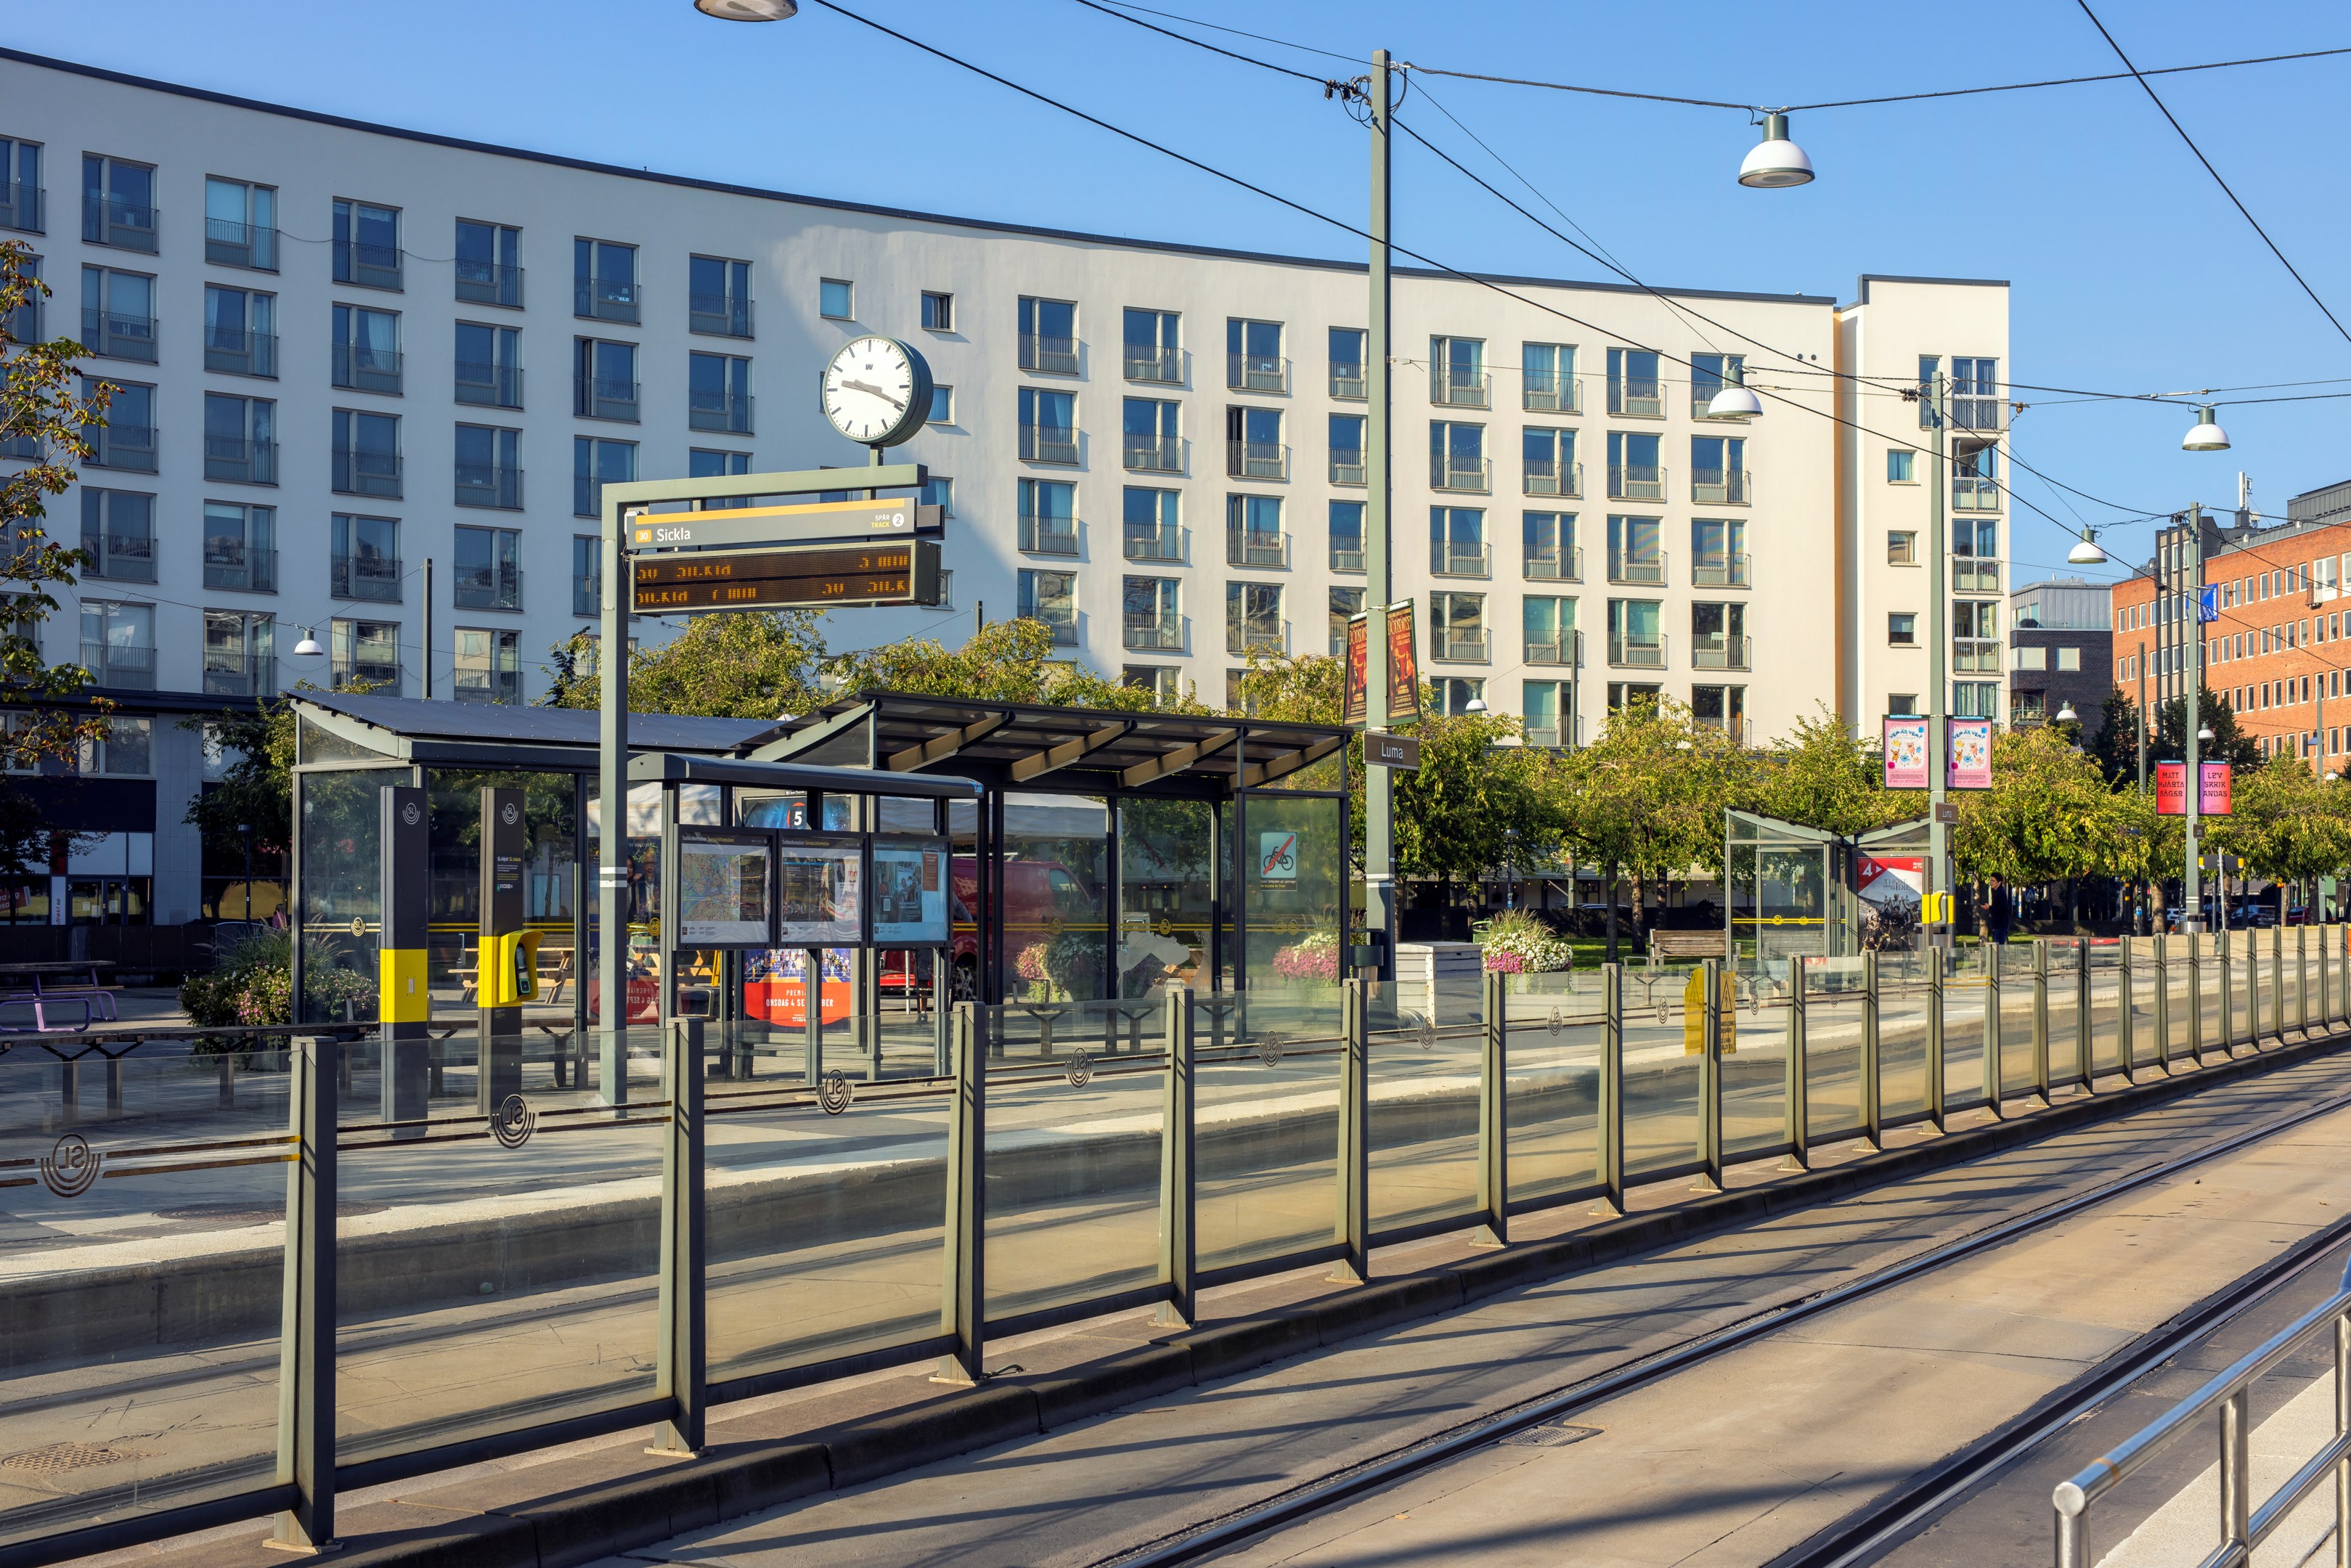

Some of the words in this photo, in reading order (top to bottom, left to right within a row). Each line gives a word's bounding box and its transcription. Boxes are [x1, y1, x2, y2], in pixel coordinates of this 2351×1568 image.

[896, 515, 901, 524] 2
[639, 532, 648, 541] 30
[656, 527, 690, 542] Sickla
[1381, 742, 1403, 759] Luma
[794, 811, 802, 825] 5
[1862, 862, 1873, 877] 4
